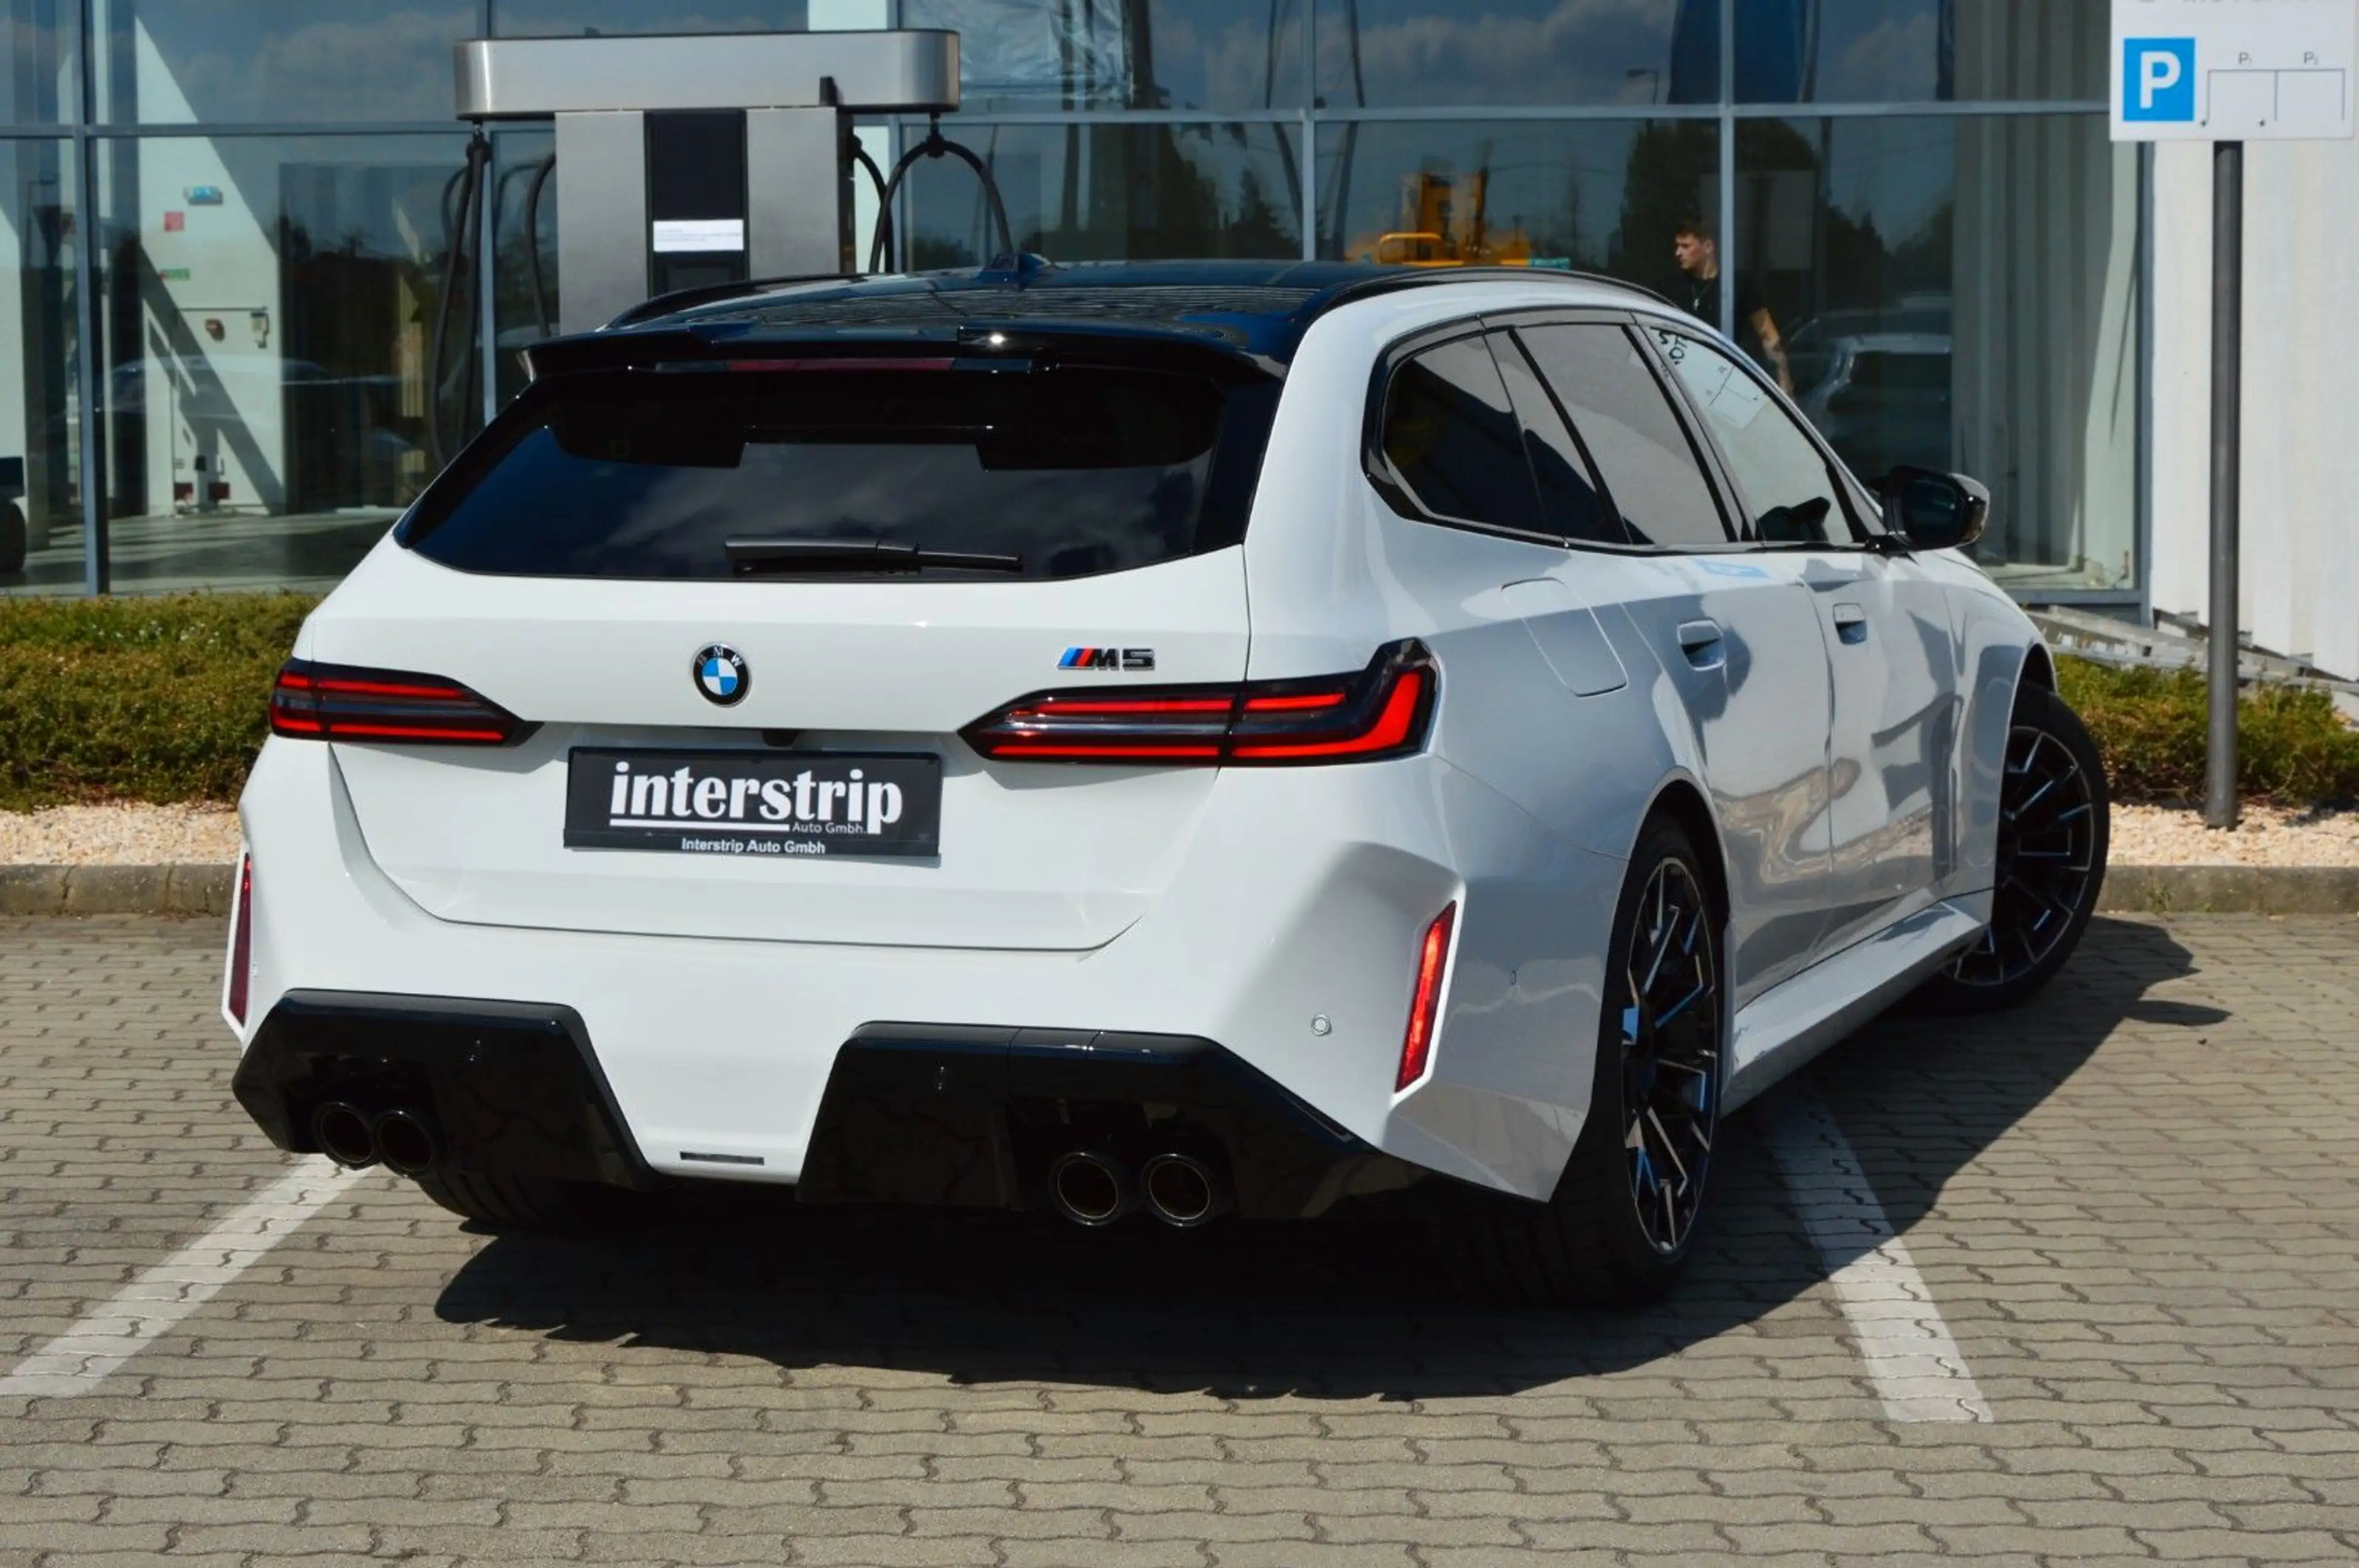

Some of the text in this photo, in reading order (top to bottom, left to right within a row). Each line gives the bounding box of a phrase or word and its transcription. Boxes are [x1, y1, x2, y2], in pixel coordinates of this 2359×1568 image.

[2140, 51, 2181, 109] P
[1087, 648, 1155, 671] M5
[610, 761, 902, 834] interstrip
[792, 822, 822, 833] Auto
[681, 837, 826, 854] Interstrip Auto Gmbh
